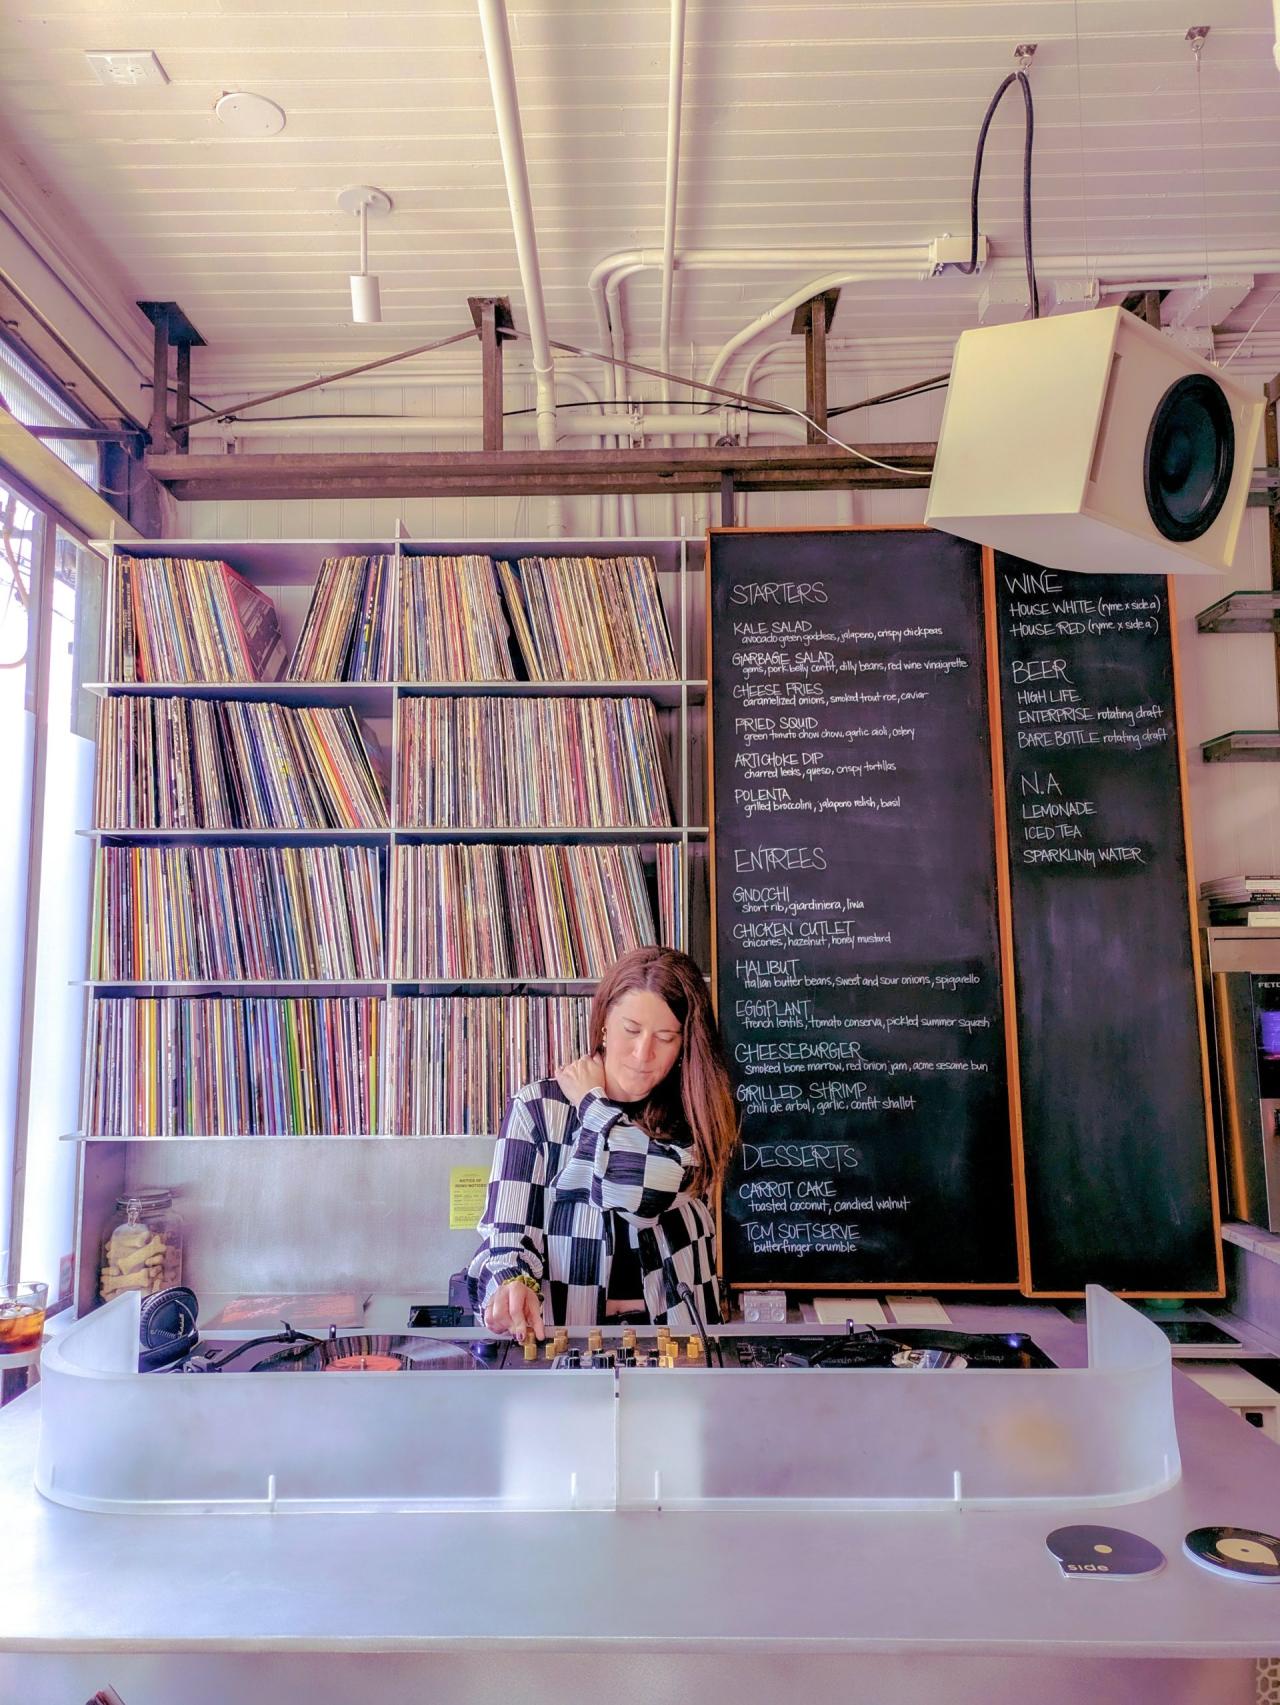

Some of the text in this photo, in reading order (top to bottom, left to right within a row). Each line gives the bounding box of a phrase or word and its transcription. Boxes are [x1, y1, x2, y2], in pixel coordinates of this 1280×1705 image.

[1004, 570, 1062, 594] WINE
[730, 582, 828, 605] STARTERS
[1009, 602, 1052, 617] HOUSE
[1053, 600, 1096, 615] WHITE
[1098, 596, 1124, 616] (ryme
[1132, 598, 1149, 609] side
[733, 620, 812, 635] KALE SALAD
[742, 634, 777, 644] avocado
[778, 633, 803, 648] green
[877, 628, 902, 638] crispy
[904, 626, 942, 637] chickpeas
[1010, 622, 1056, 637] HOUSE
[1056, 621, 1085, 635] RED
[1088, 618, 1115, 636] (ryme
[1117, 622, 1123, 631] x
[1125, 618, 1143, 628] side
[732, 652, 834, 665] GARBAGE SALAD
[742, 666, 767, 680] gems,
[767, 665, 787, 677] pork
[789, 663, 808, 679] belly
[839, 660, 857, 675] dilly
[859, 660, 887, 671] beans,
[887, 659, 902, 671] red
[904, 661, 922, 670] wine
[923, 657, 968, 672] vinaigrette
[1011, 659, 1074, 684] BEER
[733, 683, 823, 699] CHEESE FRIES
[743, 691, 928, 707] caramelized onions, smoked trout roe, caviar
[1018, 690, 1081, 704] HIGH LIFE
[1019, 705, 1163, 727] ENTERPRISE rotating draft
[735, 717, 818, 735] FRIED SQUID
[744, 732, 768, 746] green
[769, 730, 797, 739] tomato
[798, 730, 819, 739] chow
[846, 728, 869, 742] garlic
[893, 727, 915, 740] celery
[1018, 728, 1168, 750] BARE BOTTLE rotating draft
[734, 752, 824, 767] ARTICHOKE DIP
[744, 760, 897, 782] charred leeks, queso, crispy tortillas
[734, 788, 791, 804] POLENTA
[744, 802, 771, 817] grilled
[818, 799, 852, 813] jalapeno
[854, 796, 879, 809] relish,
[881, 796, 900, 808] basil
[1022, 802, 1098, 819] LEMONADE
[1024, 824, 1082, 840] ICED TEA
[734, 845, 827, 873] ENTREES
[1023, 848, 1146, 868] SPARKLING WATER
[732, 886, 789, 903] GNOCCHI
[742, 902, 773, 912] short
[774, 900, 787, 914] rib,
[789, 899, 845, 916] giardiniera,
[733, 920, 855, 939] CHICKEN CUTLET
[788, 937, 831, 950] hazelnut,
[831, 934, 855, 950] honey
[858, 932, 891, 943] mustard
[735, 959, 800, 978] HALIBUT
[744, 974, 980, 991] italian butter beans, sweet and sour onions, spigarello
[735, 1000, 812, 1018] EGGPLANT
[741, 1015, 990, 1034] french lentils, tomato conserva, pickled summer squash
[734, 1042, 867, 1063] CHEESEBURGER
[745, 1060, 988, 1075] smoked bone marrow, red onion jam, acme sesame bun
[736, 1081, 867, 1102] GRILLED SHRIMP
[747, 1102, 768, 1114] chili
[770, 1102, 783, 1113] de
[785, 1100, 815, 1113] arbol,
[851, 1095, 880, 1110] confit
[882, 1096, 916, 1110] shallot
[742, 1143, 859, 1173] DESSERTS
[739, 1181, 837, 1200] CARROT CAKE
[748, 1197, 911, 1215] toasted coconut, candied walnut
[740, 1223, 775, 1242] TCM
[813, 1224, 862, 1240] SERVE
[753, 1241, 857, 1257] butterfinger crumble
[1067, 1564, 1110, 1572] side
